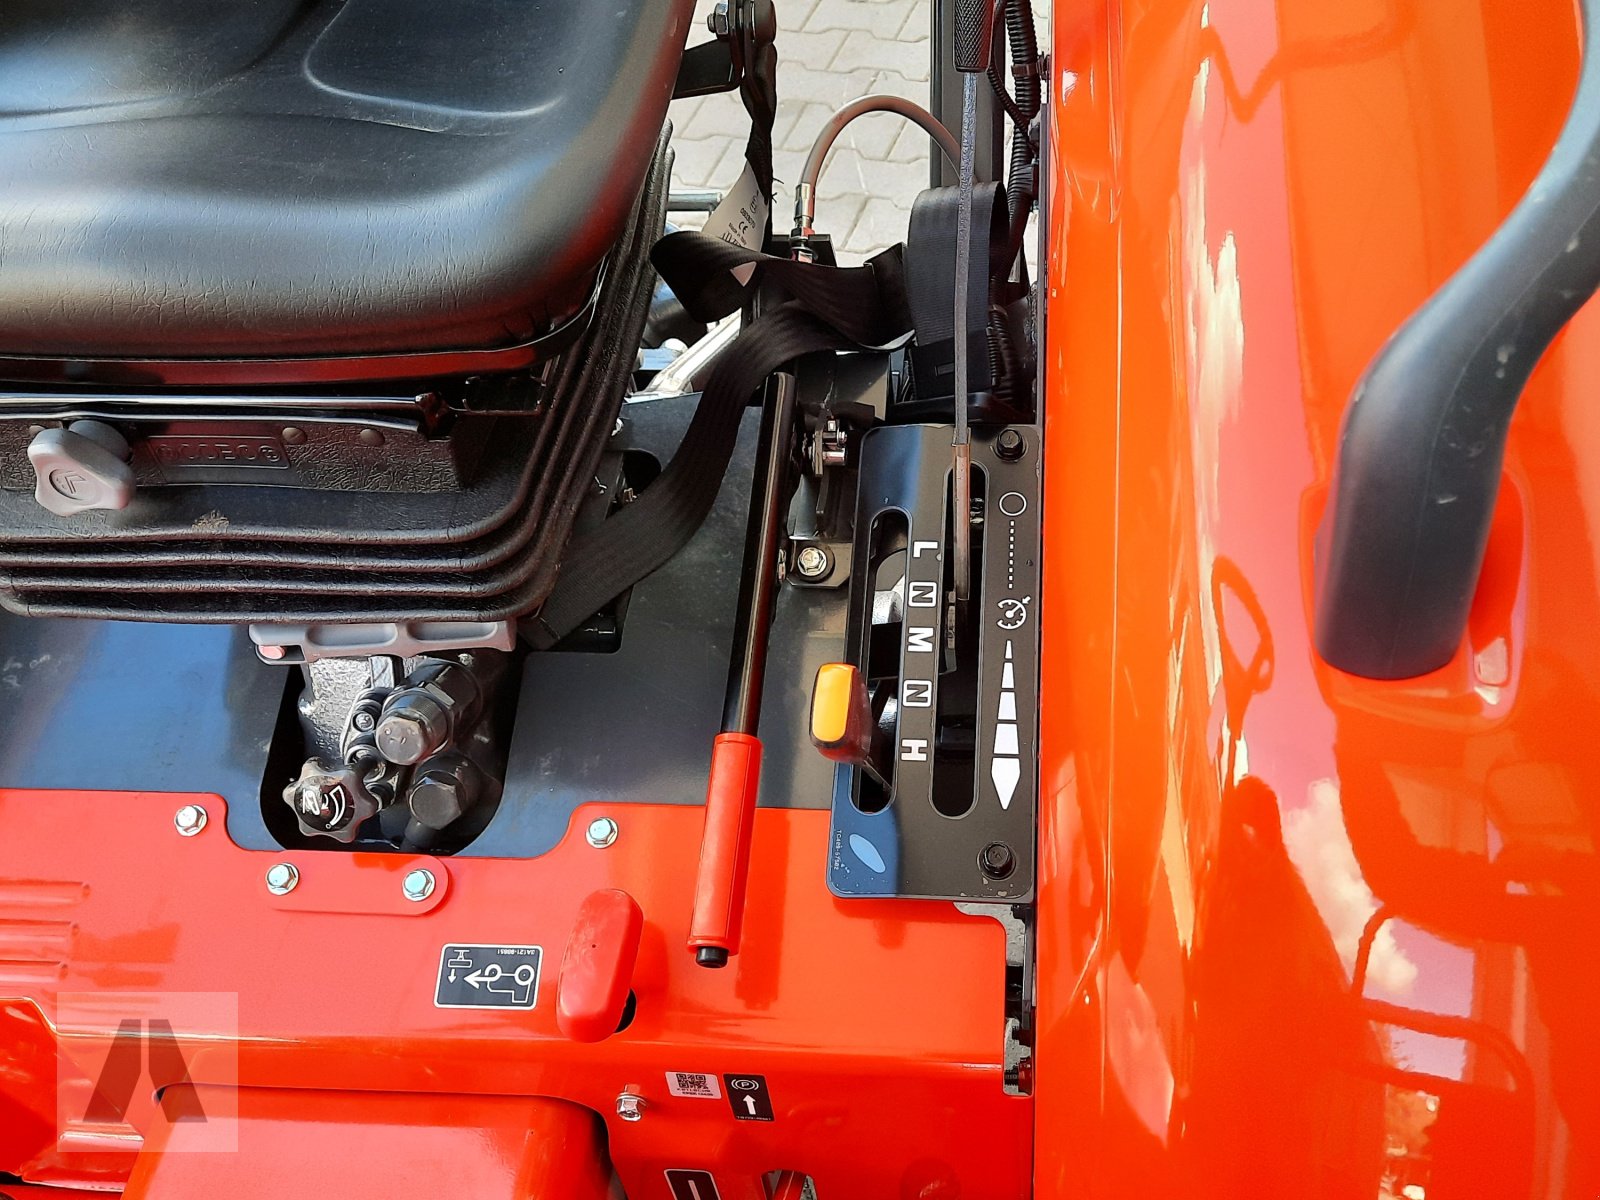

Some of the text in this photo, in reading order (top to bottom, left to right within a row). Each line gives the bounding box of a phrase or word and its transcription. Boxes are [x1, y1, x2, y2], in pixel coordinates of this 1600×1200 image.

[913, 541, 938, 558] L
[910, 583, 936, 606] N
[907, 627, 934, 652] M
[904, 681, 931, 705] N
[901, 739, 928, 761] H
